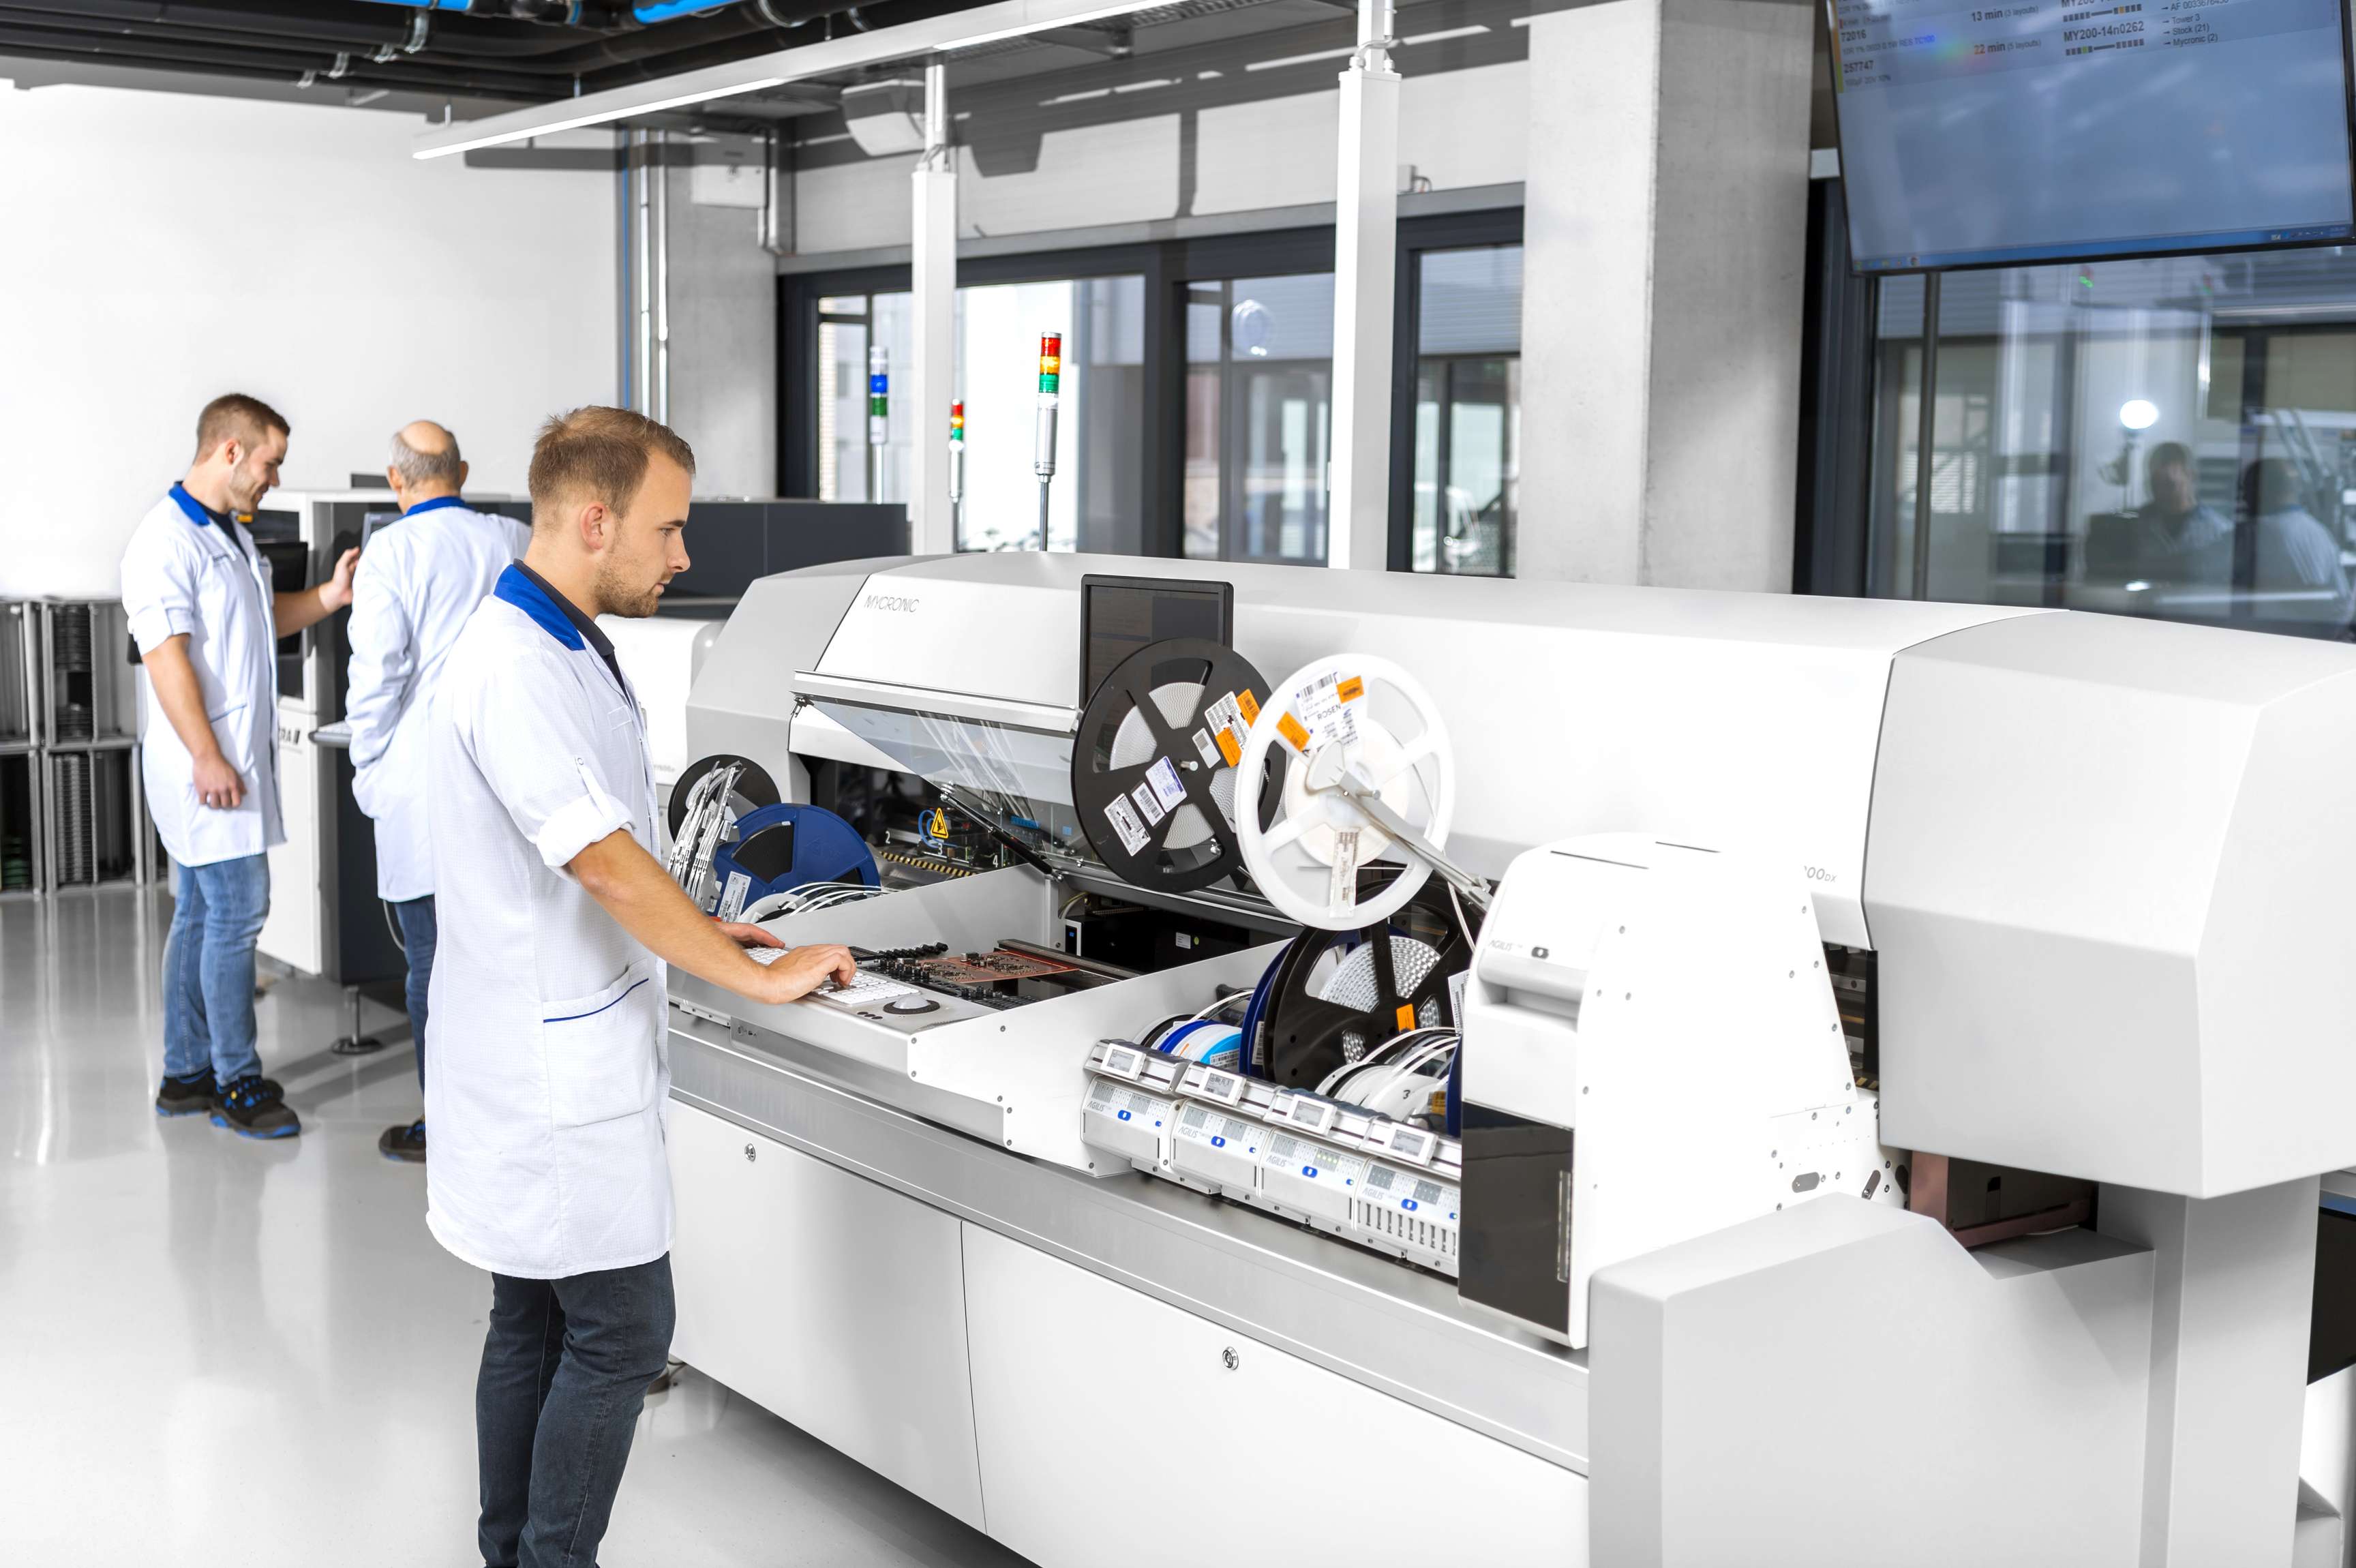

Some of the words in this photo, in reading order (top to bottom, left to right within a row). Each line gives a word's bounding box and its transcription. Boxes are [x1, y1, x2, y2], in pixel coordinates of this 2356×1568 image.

[1972, 12, 1982, 22] 13
[1984, 9, 2003, 20] min
[2012, 5, 2039, 16] layouts)
[2171, 3, 2181, 11] AF
[2171, 16, 2194, 24] Tower
[2064, 20, 2145, 42] MY200-14n0262
[2173, 27, 2193, 35] Stock
[2194, 22, 2209, 33] (21)
[1841, 29, 1867, 42] 72016
[2173, 36, 2205, 47] Mycronic
[2207, 33, 2218, 43] (2)
[1974, 44, 1985, 55] 22
[1987, 42, 2006, 52] min
[2015, 39, 2042, 50] layouts)
[1844, 60, 1873, 74] 257747
[864, 594, 920, 612] MYCRONIC
[1317, 703, 1342, 721] ROSEN
[885, 830, 891, 844] 2
[937, 843, 943, 856] 3
[992, 854, 999, 868] 4
[1489, 939, 1513, 952] AGILIS
[1403, 1089, 1410, 1100] 3
[1087, 1100, 1105, 1112] AGILIS
[1178, 1126, 1199, 1139] AGILIS
[1266, 1155, 1286, 1167] AGILIS
[1362, 1187, 1384, 1200] AGILIS
